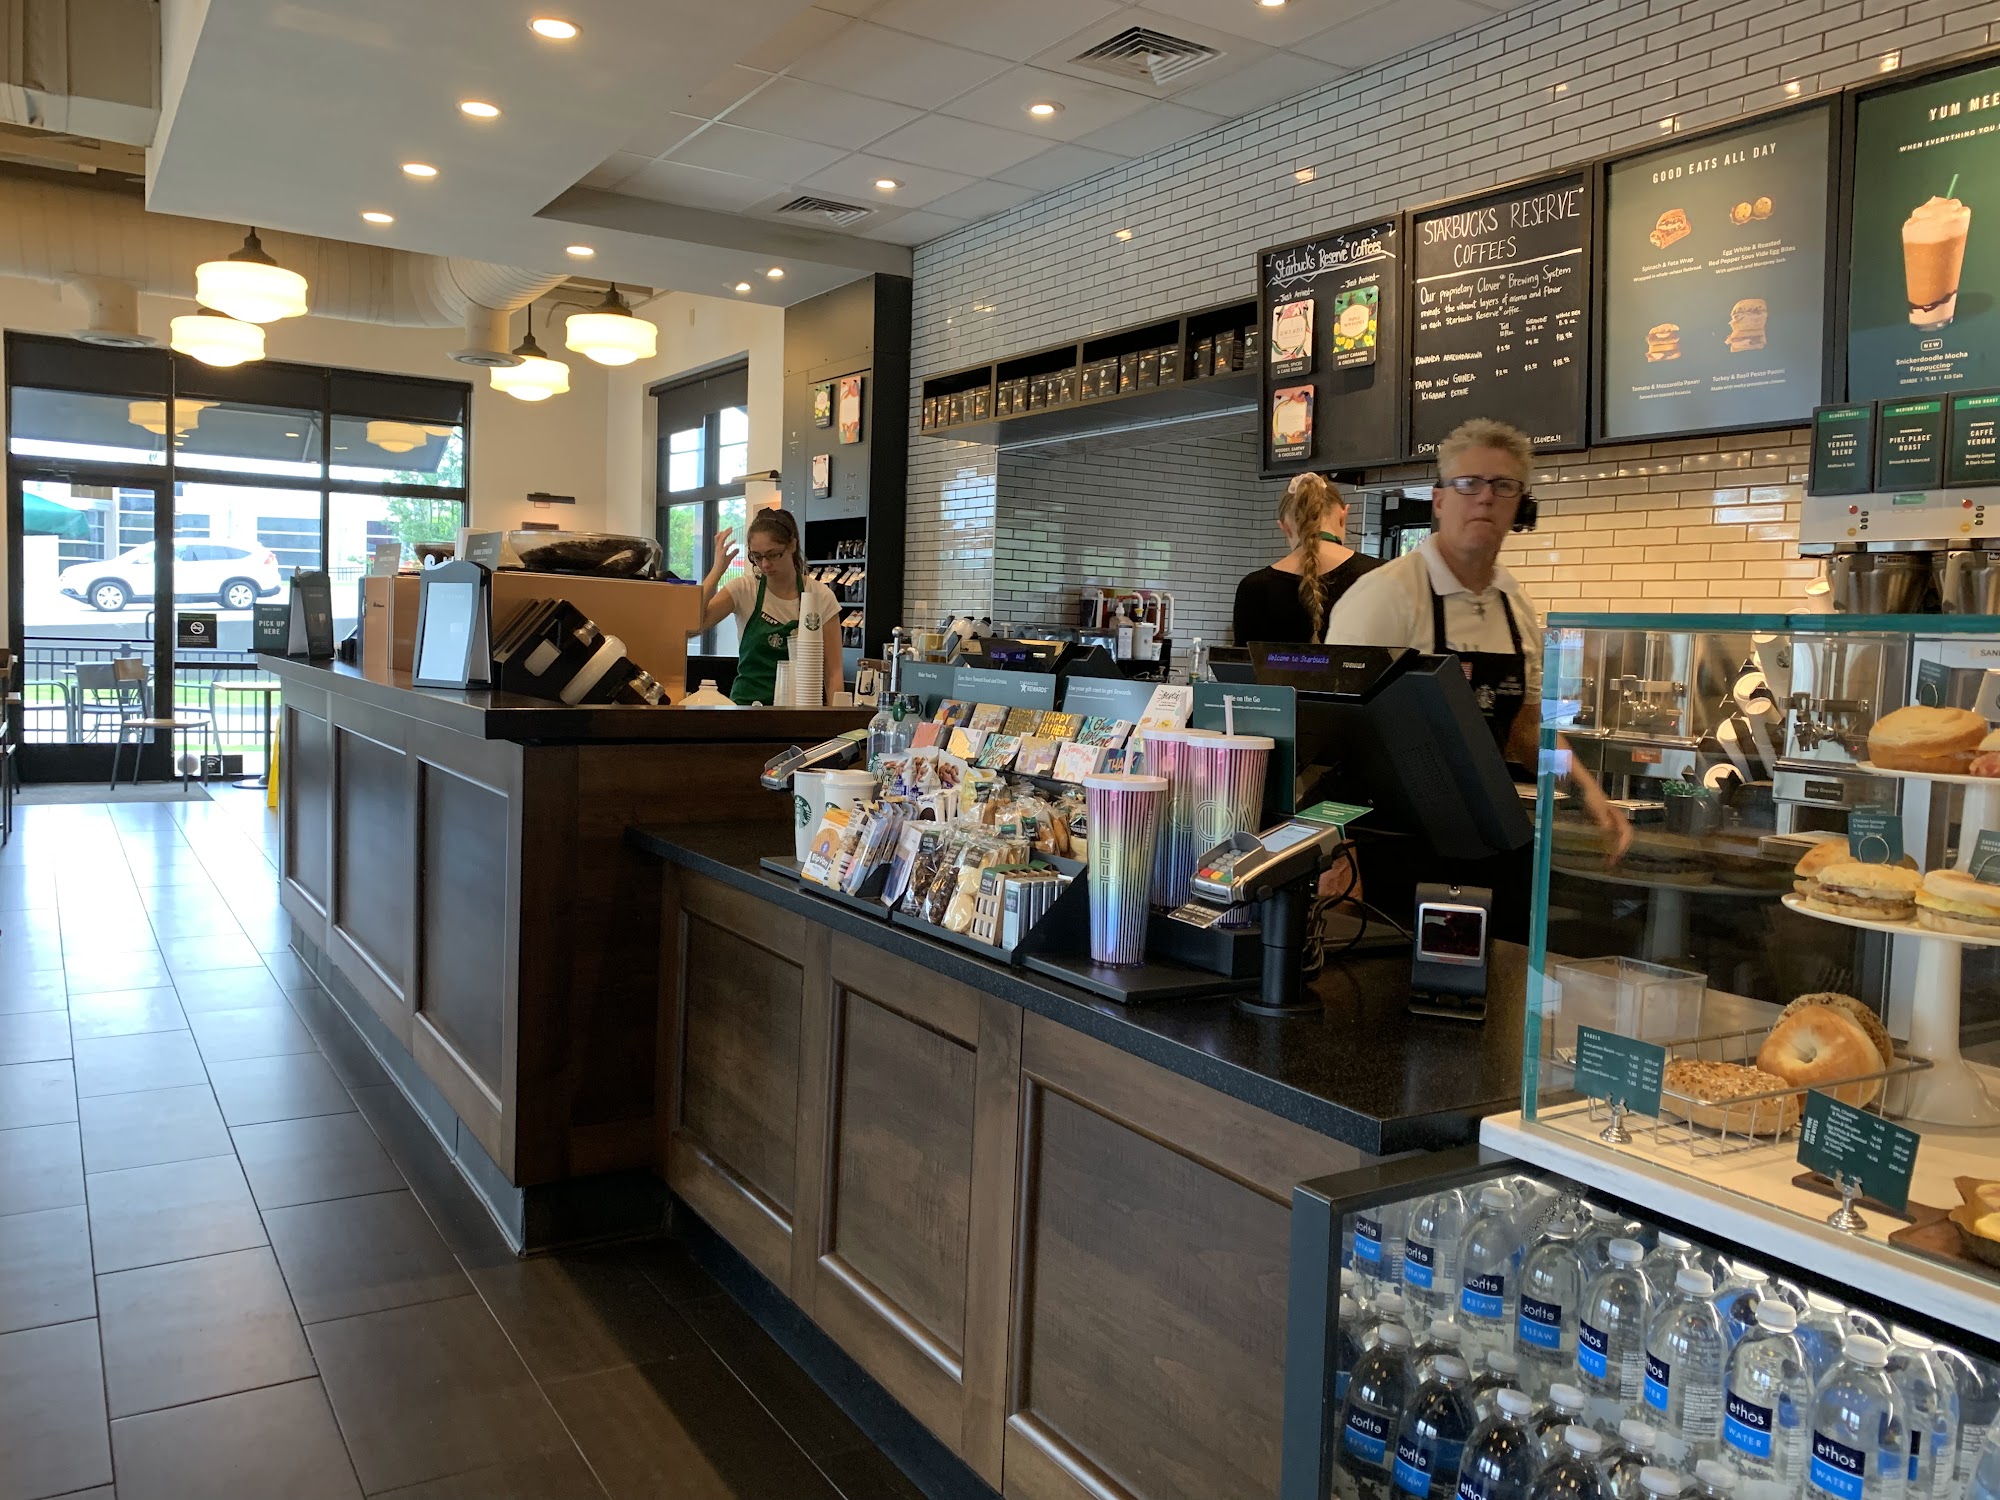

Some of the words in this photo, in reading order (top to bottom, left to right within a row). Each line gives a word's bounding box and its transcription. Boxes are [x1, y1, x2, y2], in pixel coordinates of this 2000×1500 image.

[1928, 101, 1960, 121] YUM
[1900, 142, 1923, 152] WHEN
[1925, 129, 1976, 146] EVERYTHING
[1978, 124, 1996, 134] YOU
[1652, 166, 1683, 184] GOOD
[1688, 157, 1718, 176] EATS
[1724, 150, 1746, 166] ALL
[1753, 142, 1777, 159] DAY
[1423, 207, 1499, 245] STARBUCKS
[1453, 235, 1517, 268] COFFEES
[1734, 245, 1751, 254] White
[1758, 239, 1782, 249] Roasted
[1275, 251, 1316, 280] Starbucks
[1350, 237, 1382, 260] Coffees
[1720, 256, 1740, 264] Pepper
[1420, 286, 1436, 306] Our
[1508, 272, 1540, 288] Brewing
[1542, 264, 1572, 284] System
[1444, 304, 1456, 314] the
[1456, 300, 1478, 310] vibrant
[1480, 298, 1499, 310] layers
[1502, 292, 1508, 306] of
[1528, 288, 1542, 298] and
[1543, 285, 1562, 298] flavor
[1420, 322, 1428, 330] in
[1429, 320, 1442, 329] each
[1446, 314, 1473, 326] Starbucks
[1896, 354, 1944, 366] Snickerdoodle
[1944, 351, 1968, 360] Mocha
[1436, 376, 1450, 388] NEW
[1828, 440, 1858, 448] VERANDA
[1908, 434, 1932, 442] PLACE
[1899, 444, 1922, 452] ROAST
[1268, 654, 1290, 662] Welcome
[1300, 656, 1330, 664] Starbucks
[1042, 710, 1072, 725] HAPPY
[1038, 723, 1074, 737] FATHER'S
[1108, 756, 1138, 770] THAK
[1729, 1402, 1765, 1426] ethos
[1728, 1426, 1762, 1448] WATER
[1817, 1442, 1857, 1470] ethos
[1816, 1466, 1854, 1493] WATER
